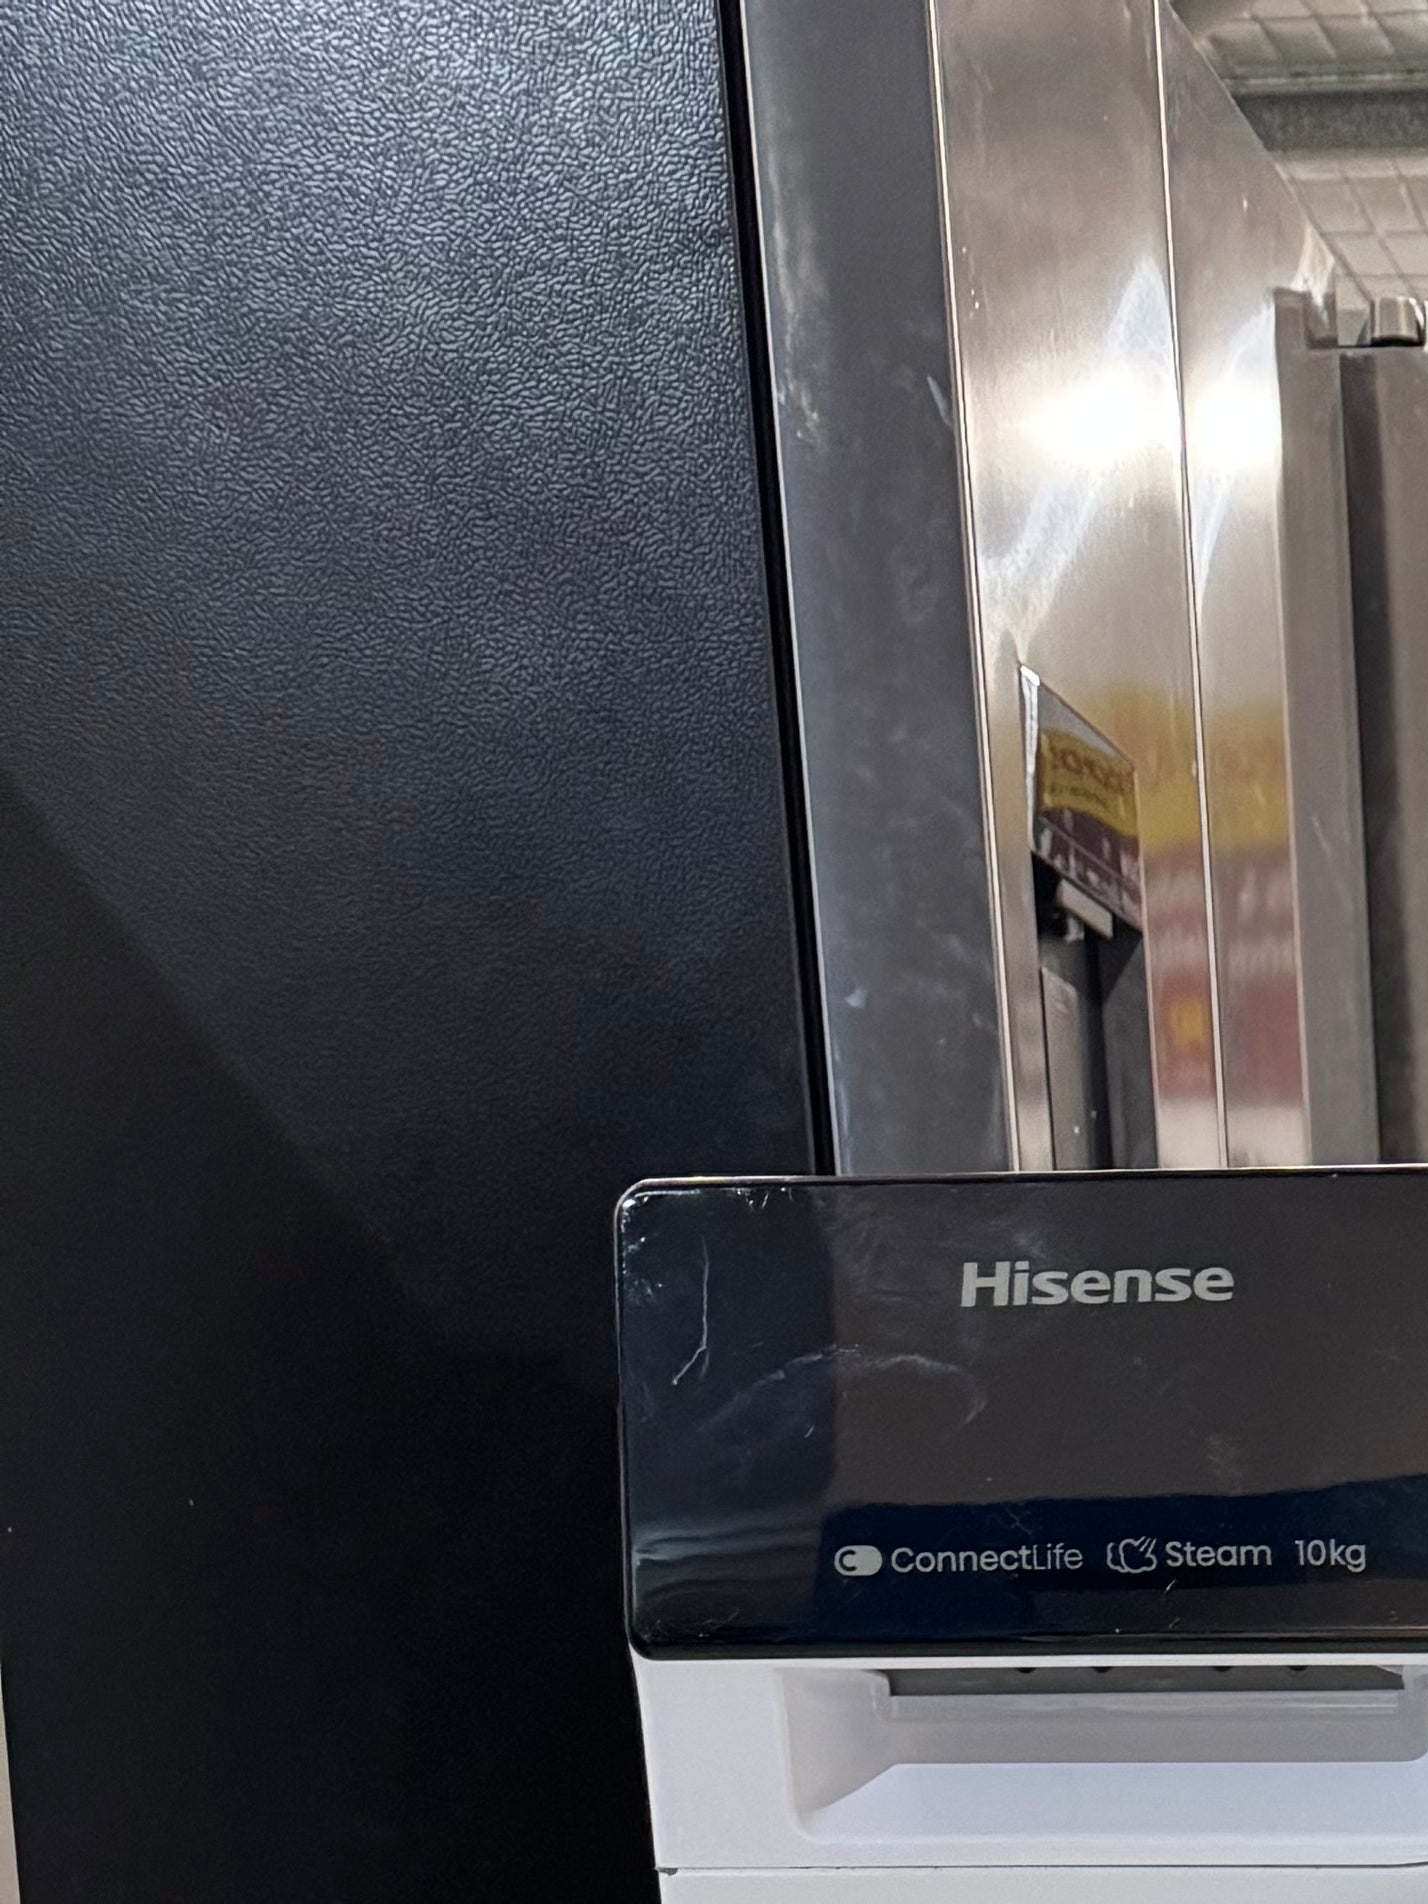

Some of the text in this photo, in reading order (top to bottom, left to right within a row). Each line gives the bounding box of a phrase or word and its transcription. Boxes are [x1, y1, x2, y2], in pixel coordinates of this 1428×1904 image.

[961, 1261, 1234, 1307] Hisense
[891, 1544, 1083, 1574] ConnectLife
[1165, 1537, 1366, 1572] Steam 10kg
